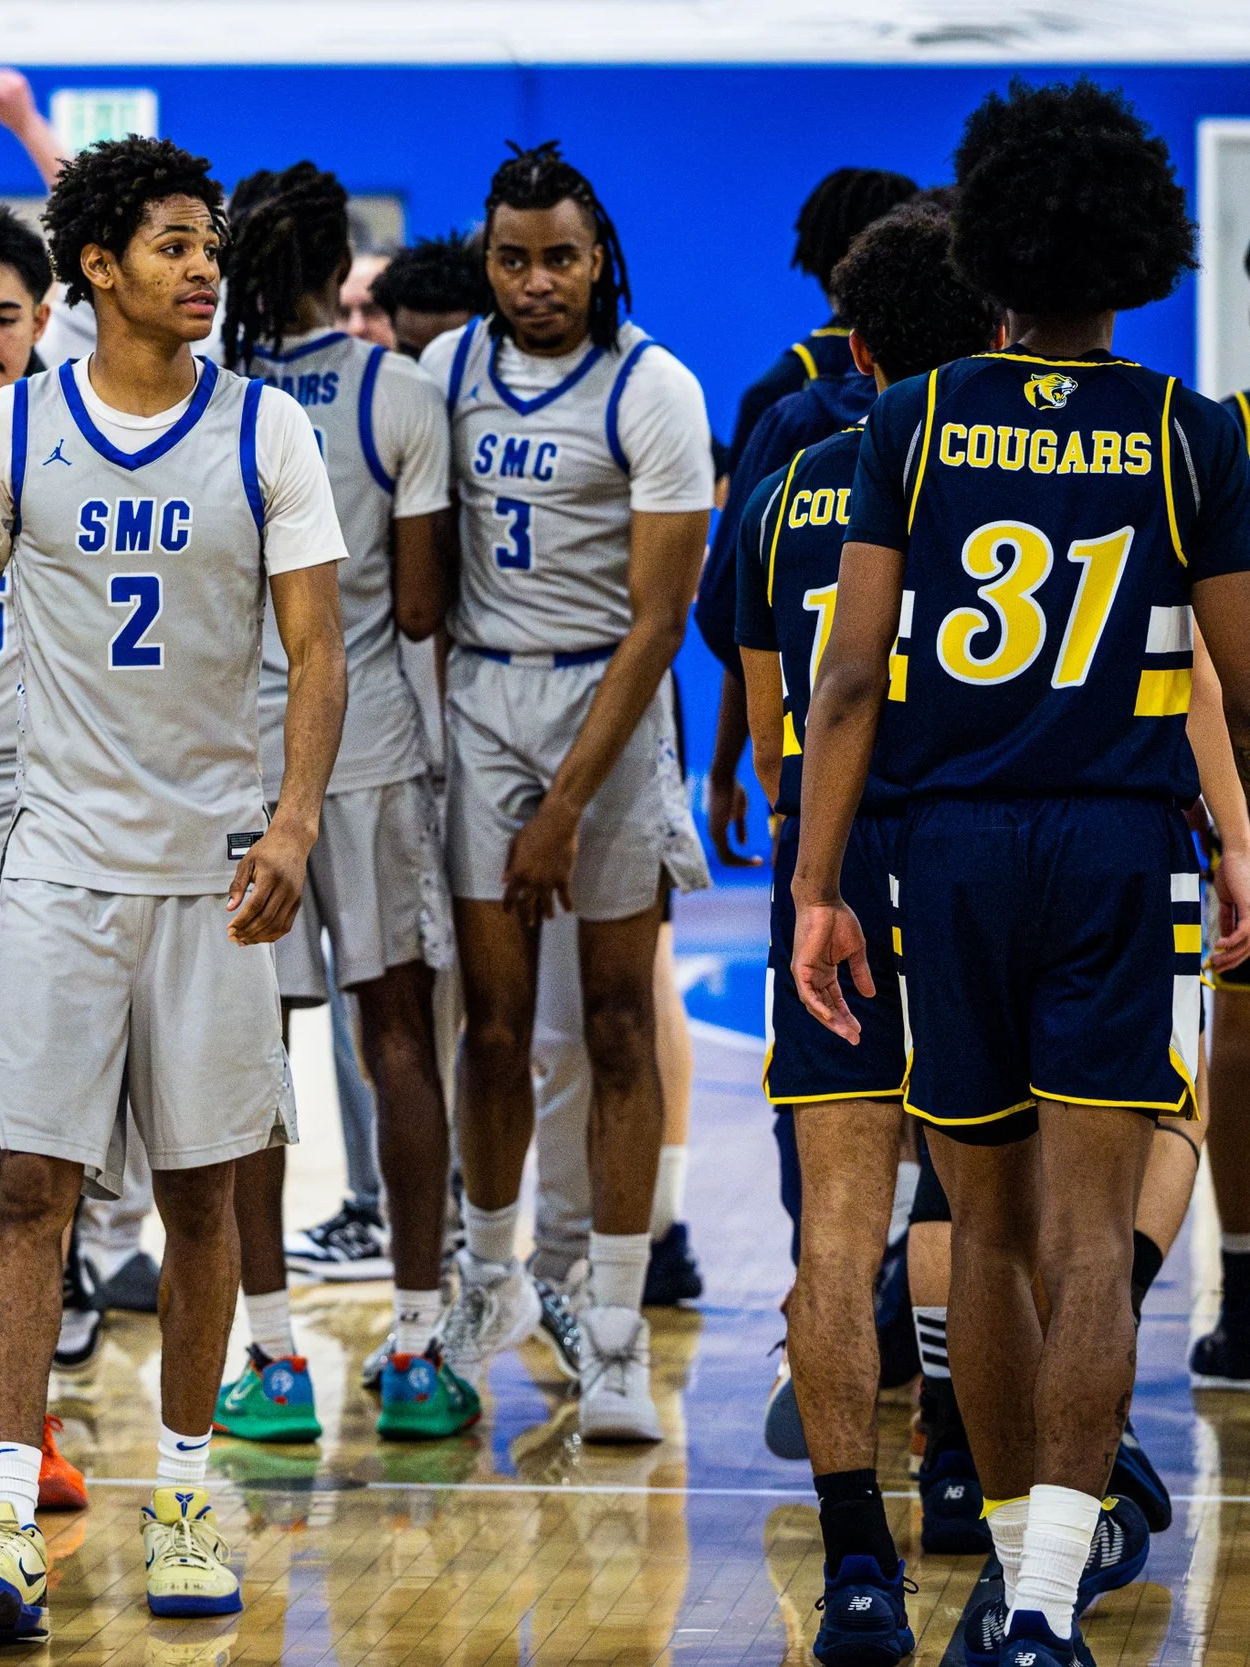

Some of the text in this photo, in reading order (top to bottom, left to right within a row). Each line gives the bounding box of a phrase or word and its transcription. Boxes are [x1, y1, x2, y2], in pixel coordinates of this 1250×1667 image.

[472, 431, 559, 483] SMC
[939, 422, 1152, 475] COUGARS
[75, 496, 193, 555] SMC
[494, 494, 536, 570] 3
[107, 572, 165, 671] 2
[936, 520, 1135, 690] 31
